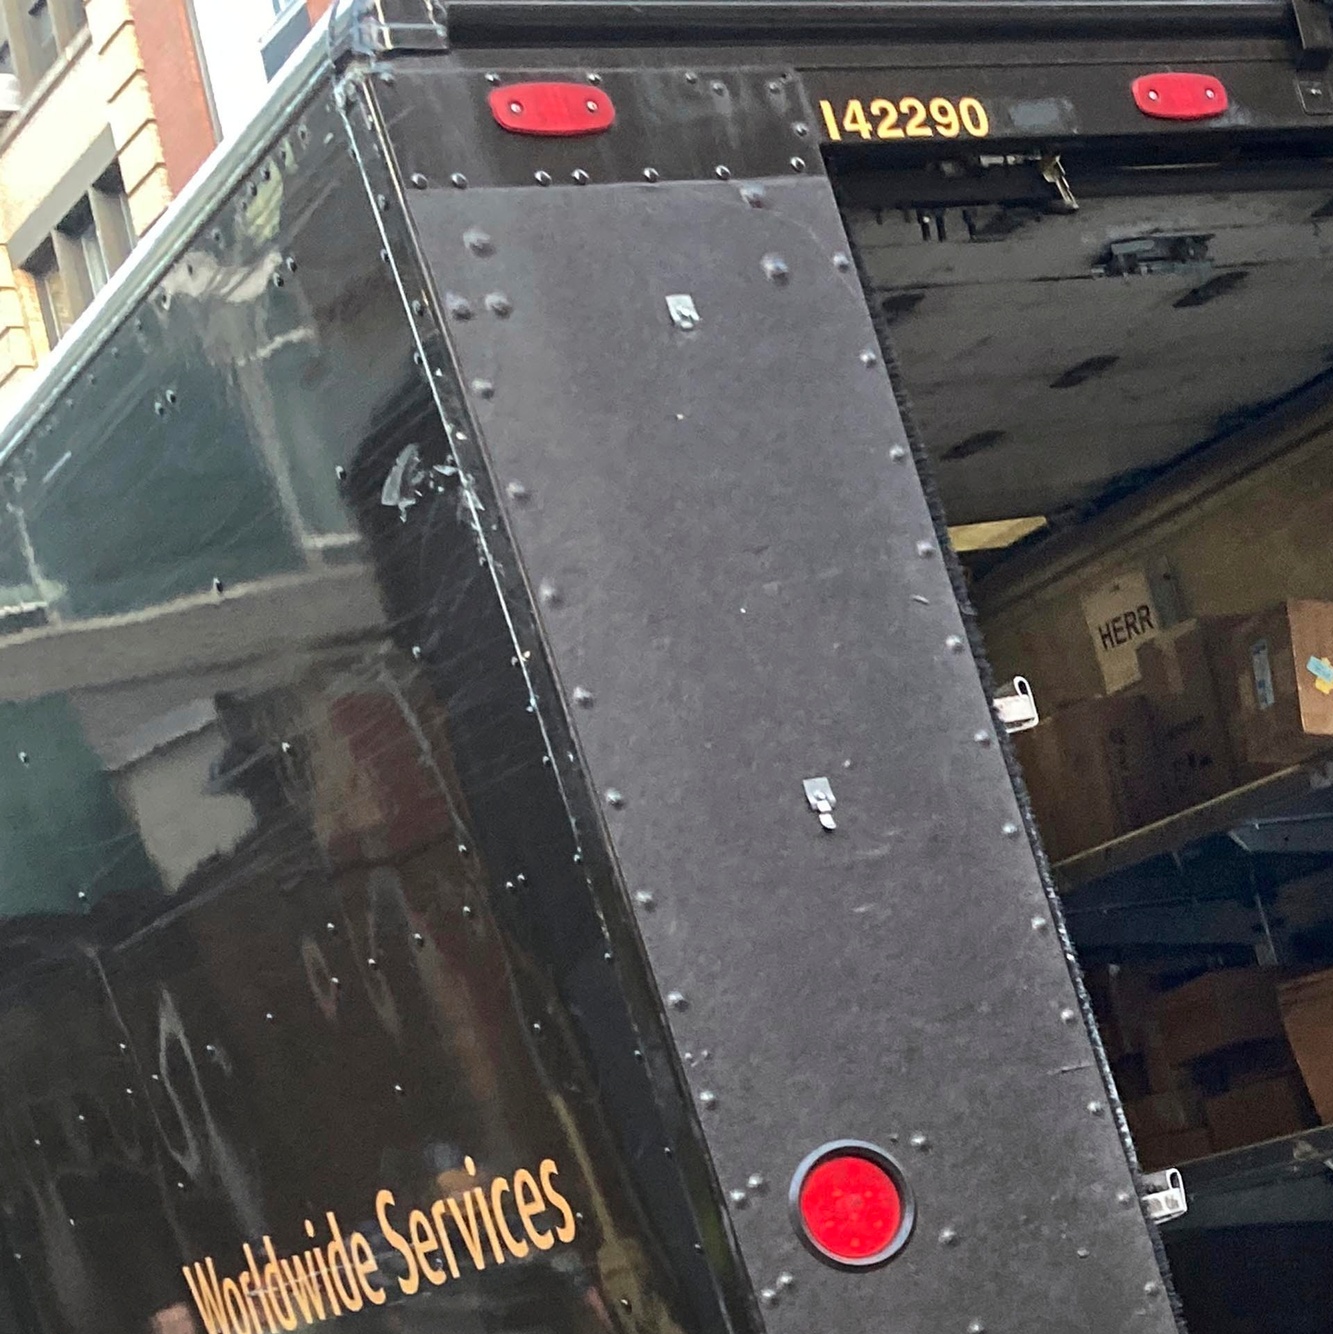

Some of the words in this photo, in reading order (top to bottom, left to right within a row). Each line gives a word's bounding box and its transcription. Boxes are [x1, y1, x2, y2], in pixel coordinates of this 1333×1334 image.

[819, 97, 989, 141] 142290
[1098, 604, 1154, 651] HERR
[375, 1155, 576, 1295] Services
